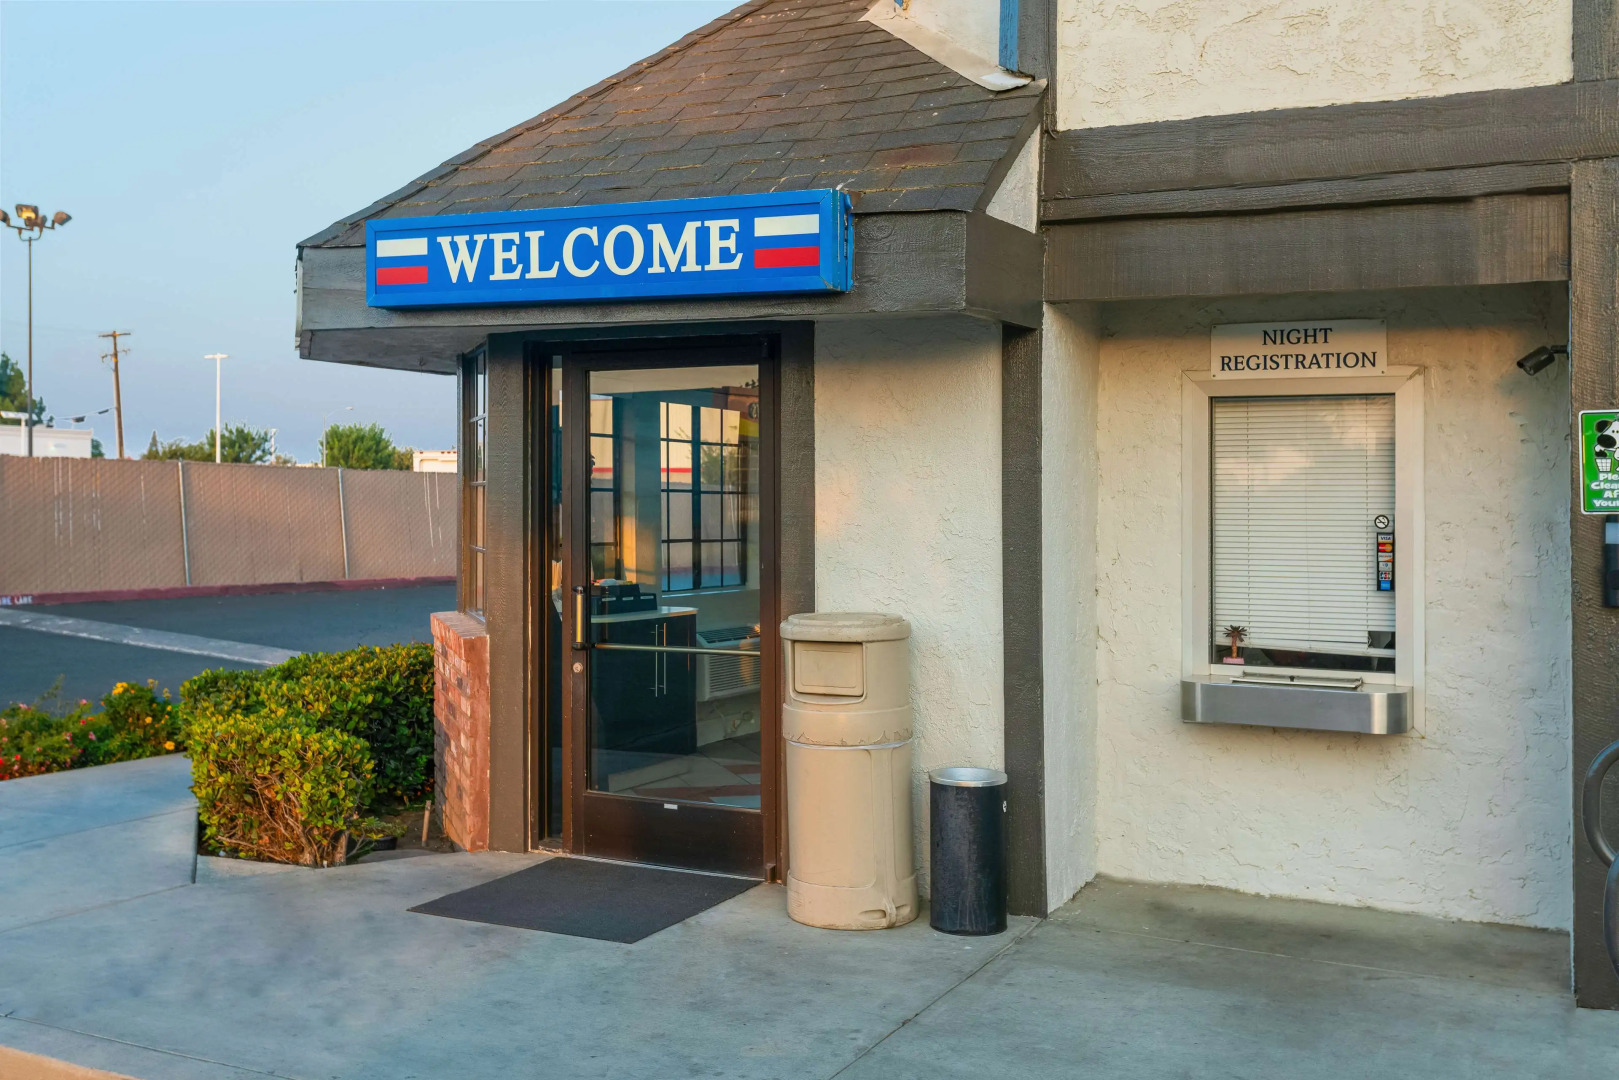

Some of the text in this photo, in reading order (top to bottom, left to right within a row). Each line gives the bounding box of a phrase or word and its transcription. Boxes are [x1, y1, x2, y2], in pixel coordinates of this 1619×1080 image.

[436, 218, 743, 284] WELCOME
[1261, 328, 1333, 345] NIGHT
[1220, 351, 1378, 371] REGISTRATION
[1599, 473, 1619, 481] Ple
